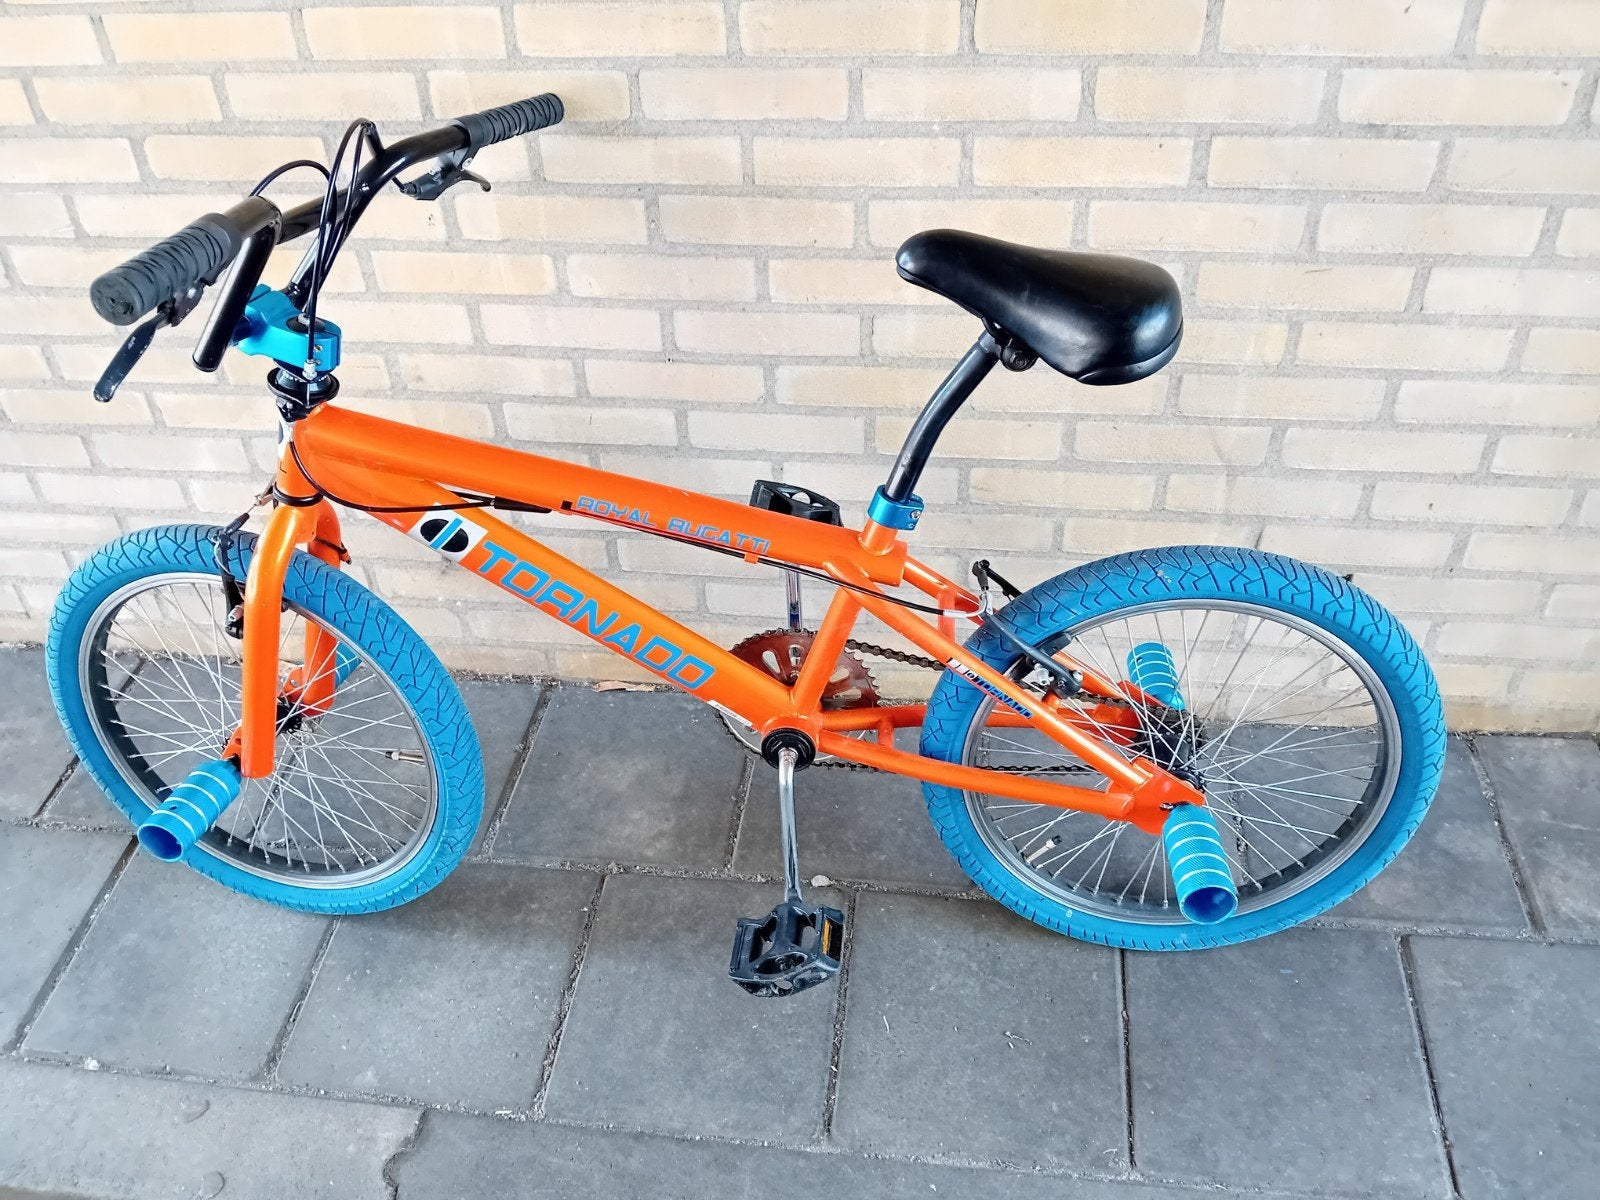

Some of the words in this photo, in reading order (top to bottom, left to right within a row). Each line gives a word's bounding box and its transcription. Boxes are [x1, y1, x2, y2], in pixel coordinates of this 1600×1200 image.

[577, 496, 656, 525] ROYAL
[668, 518, 771, 553] BUGATTI
[479, 542, 716, 690] TORNADO
